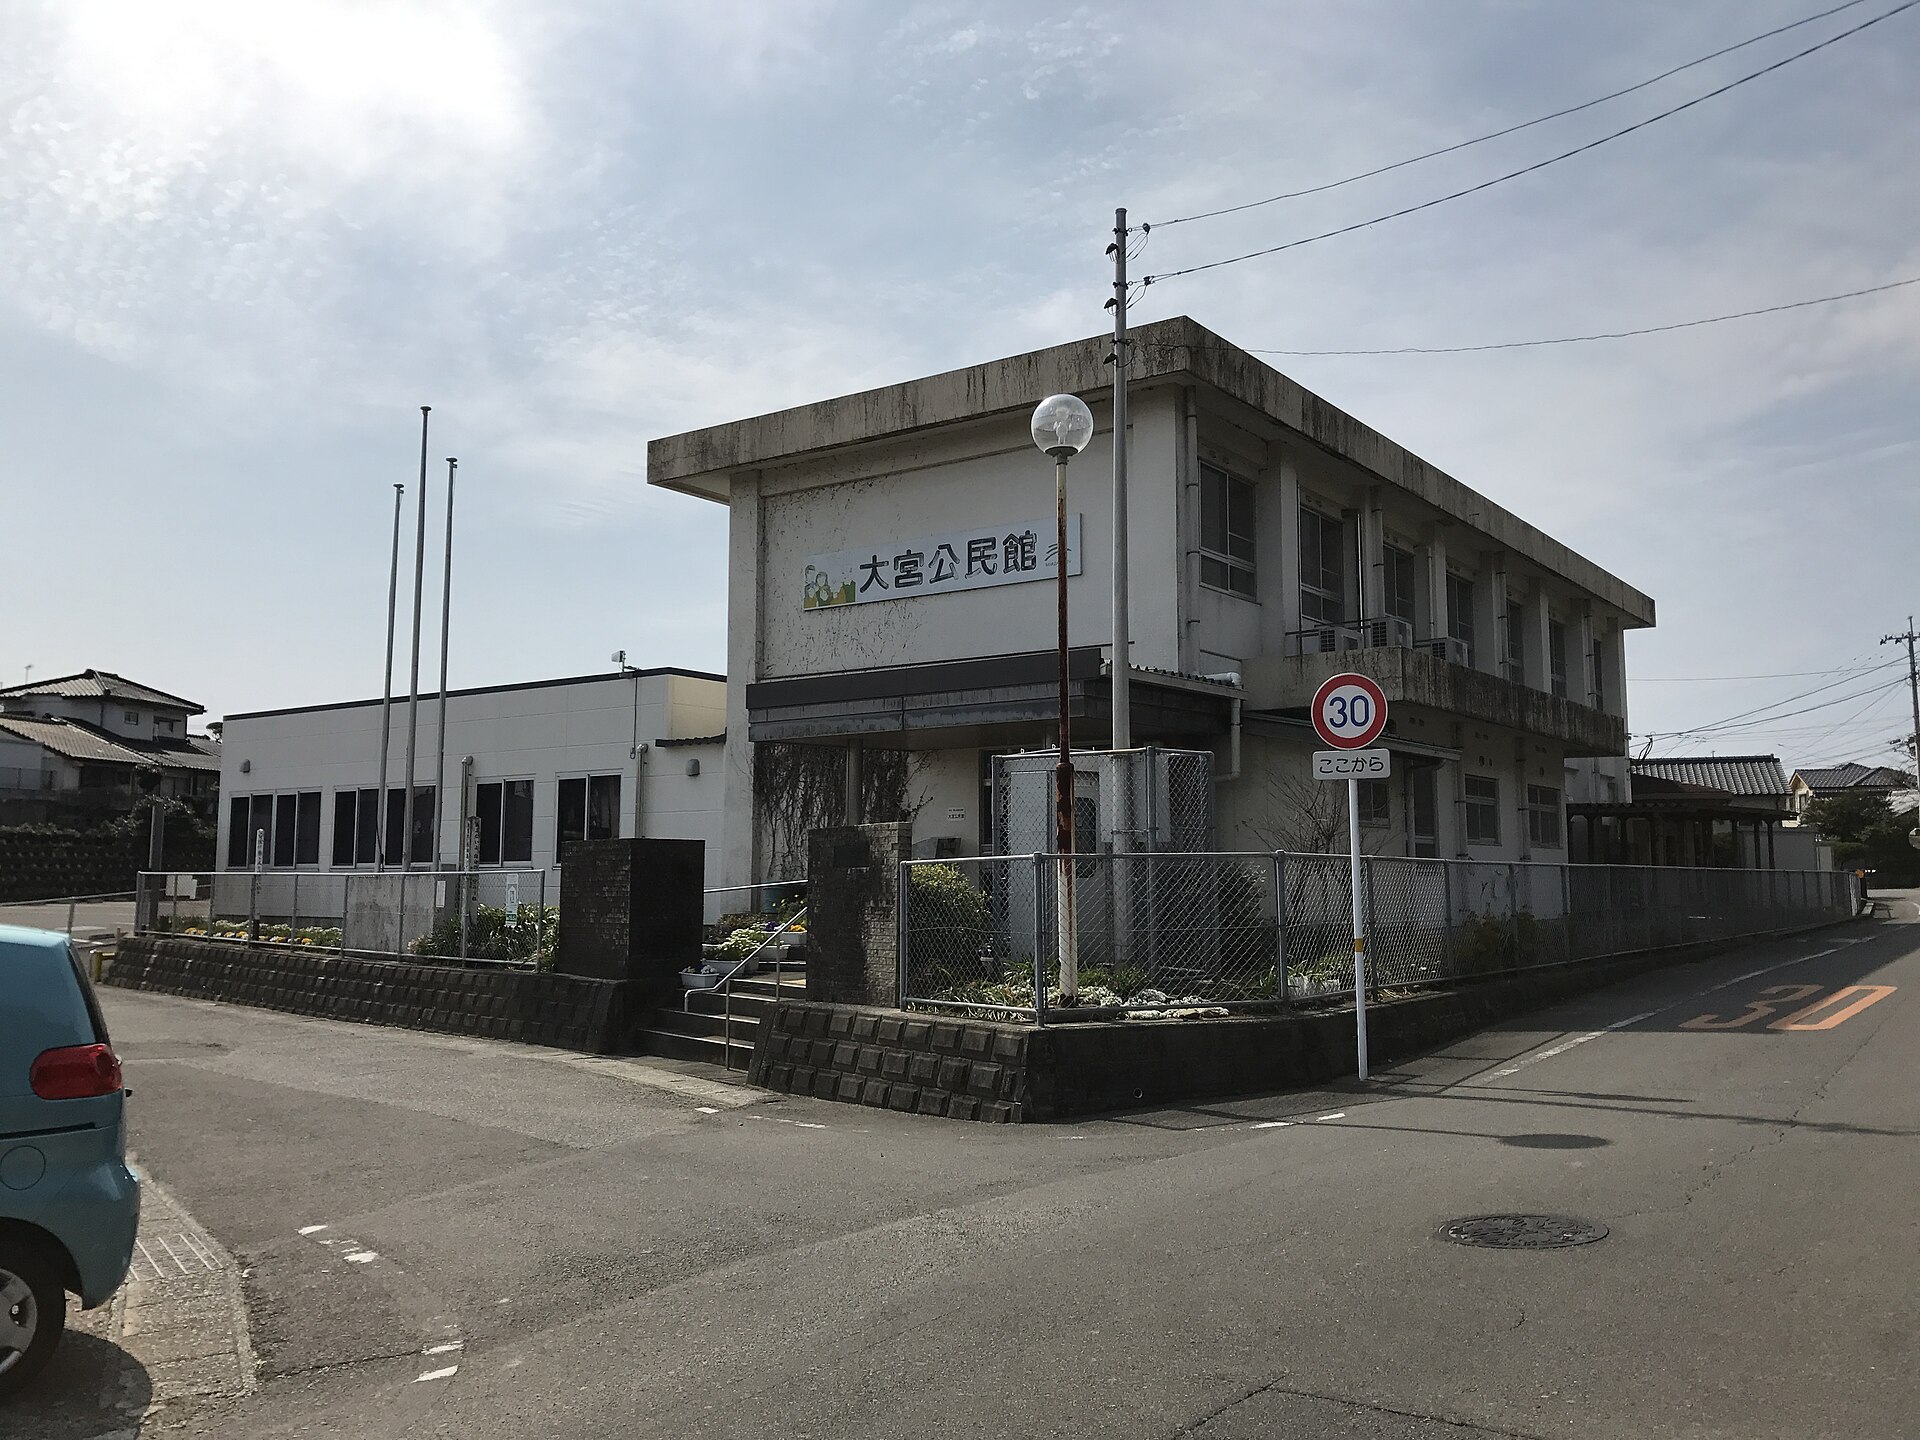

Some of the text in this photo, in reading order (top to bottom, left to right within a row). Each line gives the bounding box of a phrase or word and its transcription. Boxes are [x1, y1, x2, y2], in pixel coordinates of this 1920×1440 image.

[859, 530, 1037, 593] 大宮公民館
[1329, 695, 1369, 728] 30
[1320, 757, 1384, 773] ここから
[1678, 984, 1898, 1031] 30
